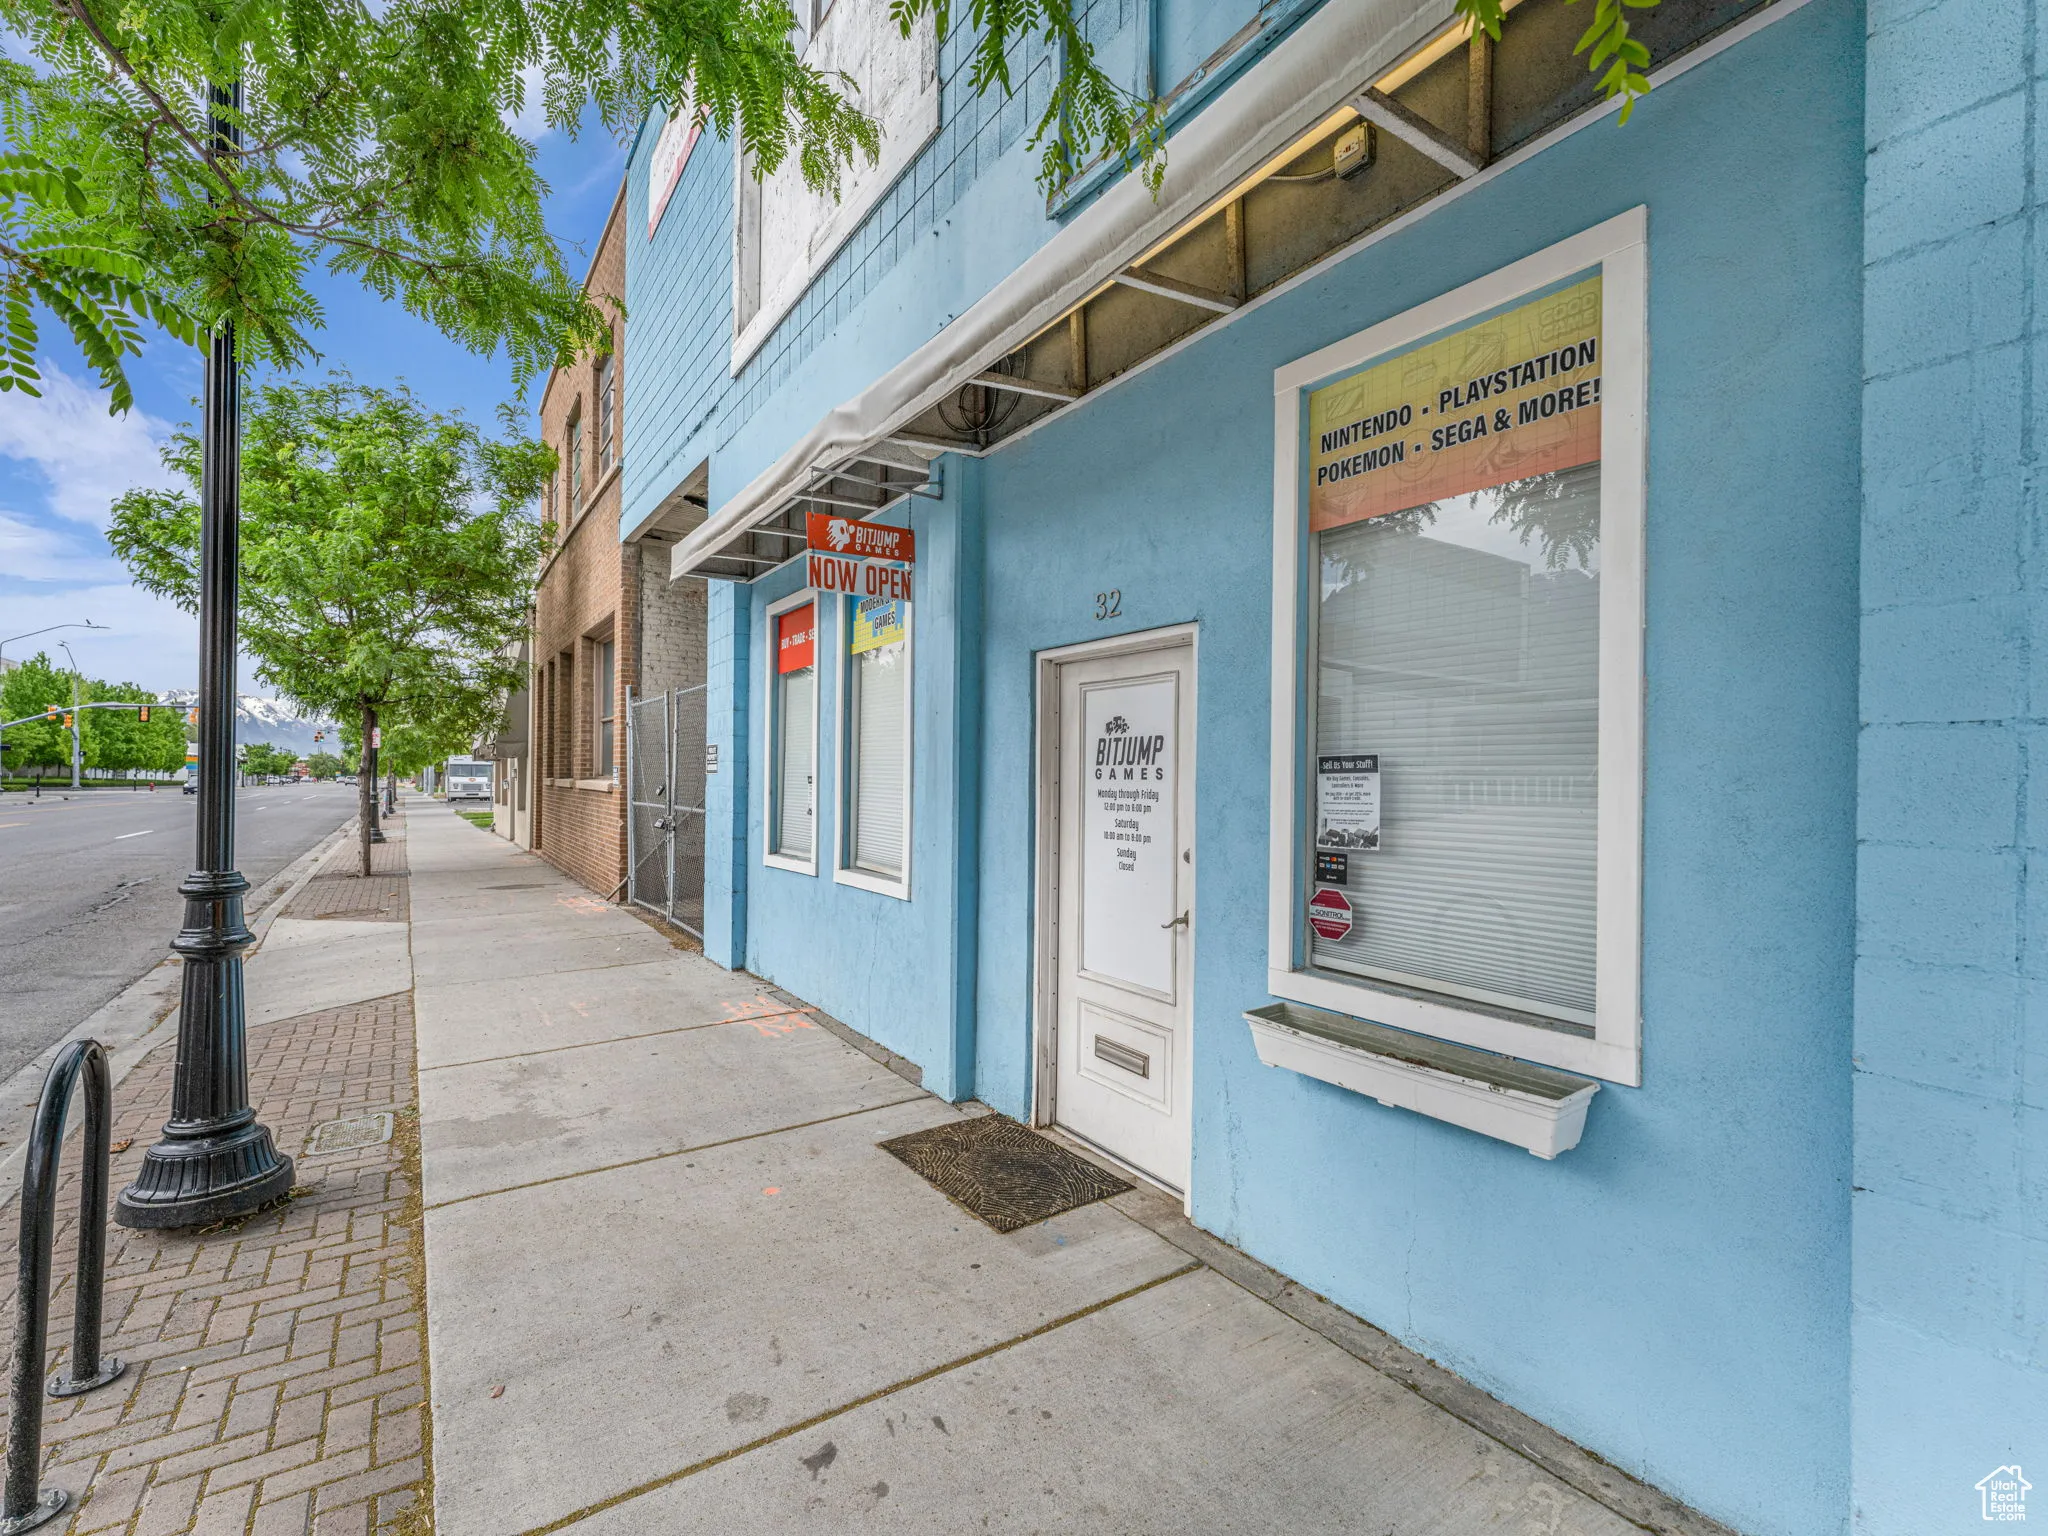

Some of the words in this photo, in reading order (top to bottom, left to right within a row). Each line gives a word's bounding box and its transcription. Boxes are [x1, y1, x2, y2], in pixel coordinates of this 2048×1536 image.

[1320, 404, 1412, 454] NINTENDO
[1438, 337, 1597, 414] PLAYSTATION
[1317, 440, 1406, 487] POKEMON
[1431, 414, 1488, 452] SEGA
[1493, 407, 1513, 433] &
[1517, 377, 1602, 426] MORE!
[855, 526, 900, 549] BITJUMP
[855, 544, 901, 557] GAMES
[808, 555, 858, 593] NOW
[865, 565, 912, 601] OPEN
[1095, 588, 1122, 620] 32
[874, 611, 896, 629] GAMES
[1095, 735, 1164, 766] BITJUMP
[1322, 761, 1333, 770] Sell
[1341, 761, 1355, 769] Your
[1355, 759, 1373, 769] Stuff!
[1095, 767, 1164, 781] GAMES
[1097, 788, 1118, 801] Monday
[1118, 788, 1140, 801] through
[1140, 789, 1160, 803] Friday
[1116, 804, 1124, 813] pm
[1125, 803, 1131, 812] to
[1143, 805, 1152, 814] pm
[1114, 818, 1139, 831] Saturday
[1116, 832, 1124, 841] am
[1124, 832, 1130, 842] to
[1143, 835, 1152, 845] pm
[1116, 847, 1137, 861] Sunday
[1118, 861, 1135, 872] Closed
